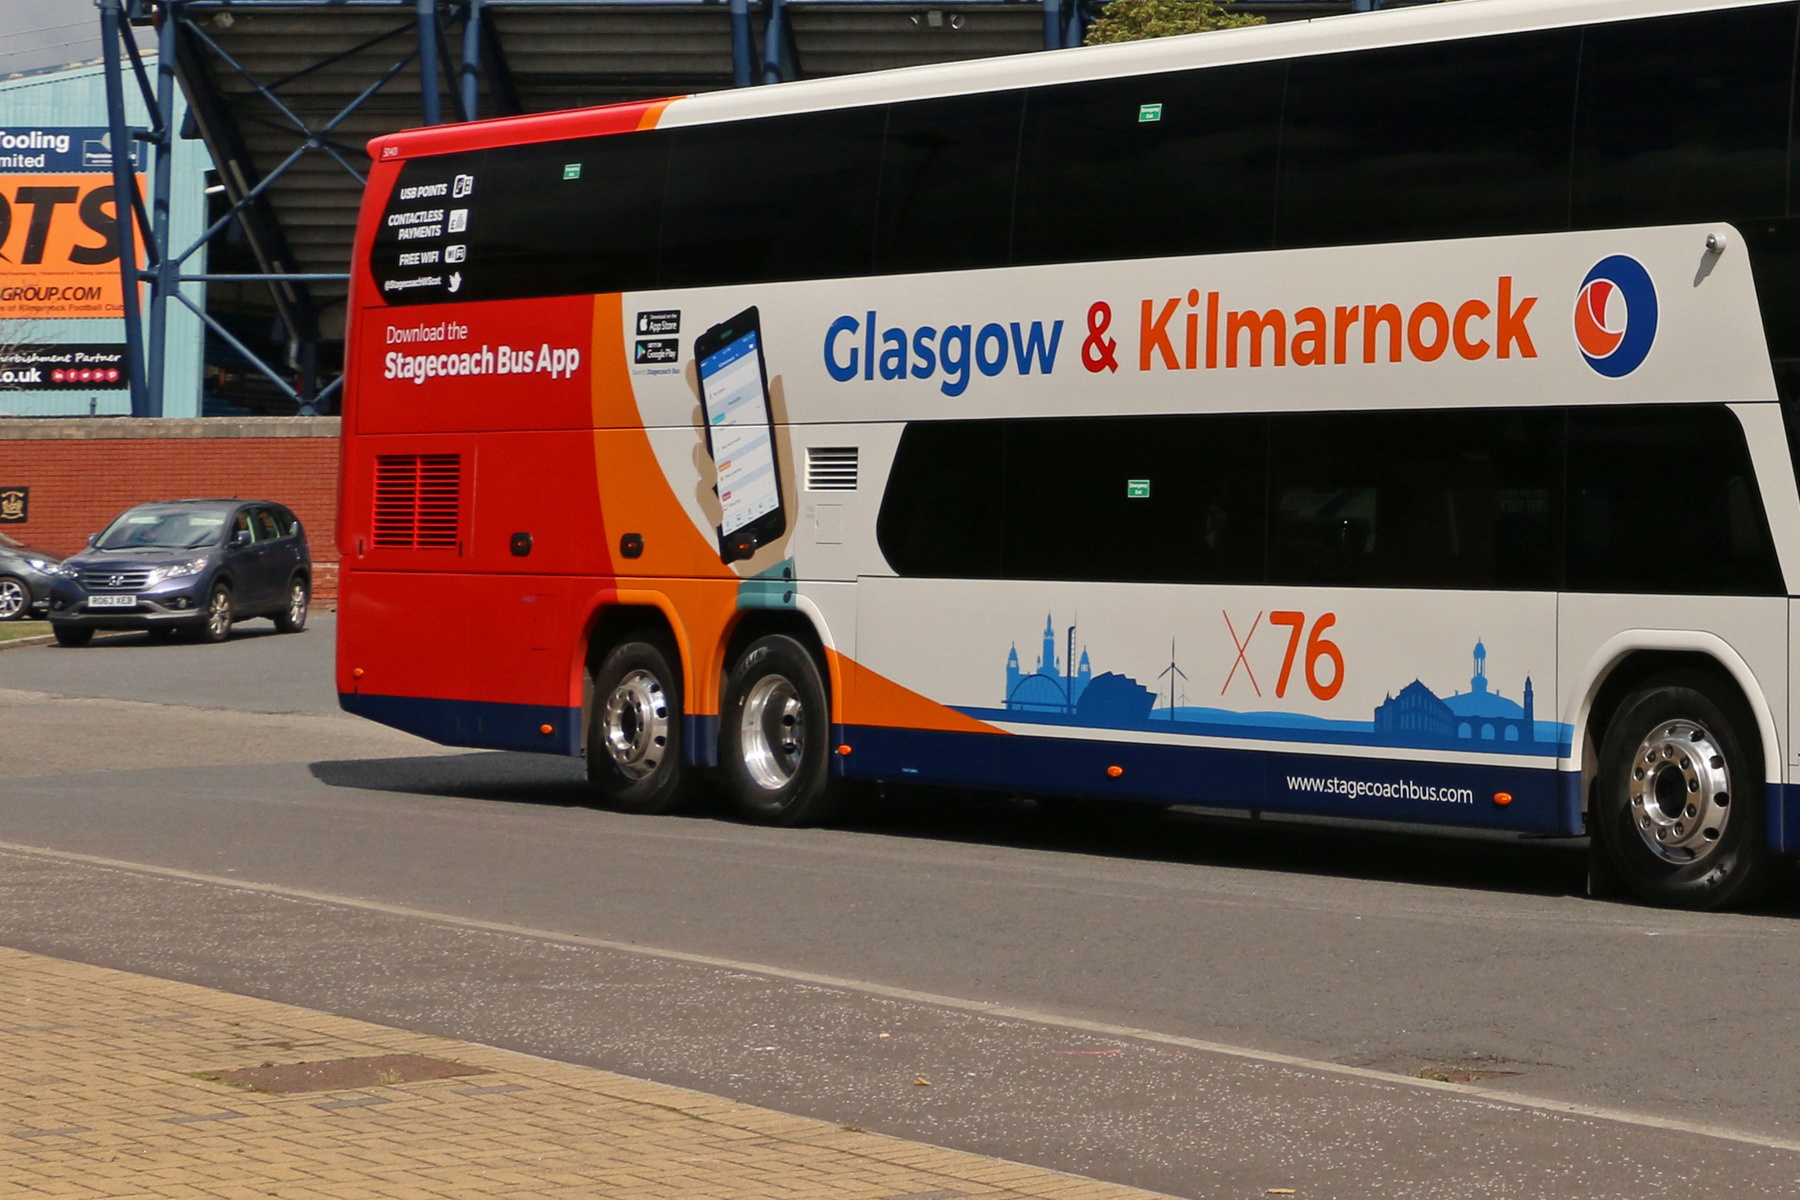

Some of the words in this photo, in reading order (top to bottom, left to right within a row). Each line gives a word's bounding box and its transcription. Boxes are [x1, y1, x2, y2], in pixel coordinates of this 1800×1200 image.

[400, 187, 417, 200] USB
[417, 183, 448, 198] POINTS
[0, 186, 120, 265] TS
[388, 209, 444, 226] CONTACTLESS
[398, 225, 442, 240] PAYMENTS
[399, 253, 420, 266] FREE
[421, 251, 439, 263] WIFI
[386, 322, 444, 344] Download
[447, 321, 468, 340] the
[650, 321, 661, 332] App
[824, 311, 1064, 397] Glasgow
[1081, 301, 1119, 374] &
[1139, 276, 1538, 371] Kilmarnock
[74, 352, 121, 363] Partner
[384, 345, 494, 384] Stagecoach
[497, 346, 534, 374] Bus
[536, 344, 580, 379] App
[0, 367, 42, 382] o.uk
[1221, 609, 1344, 700] X76
[1286, 776, 1473, 804] www.stagecoachbus.com
